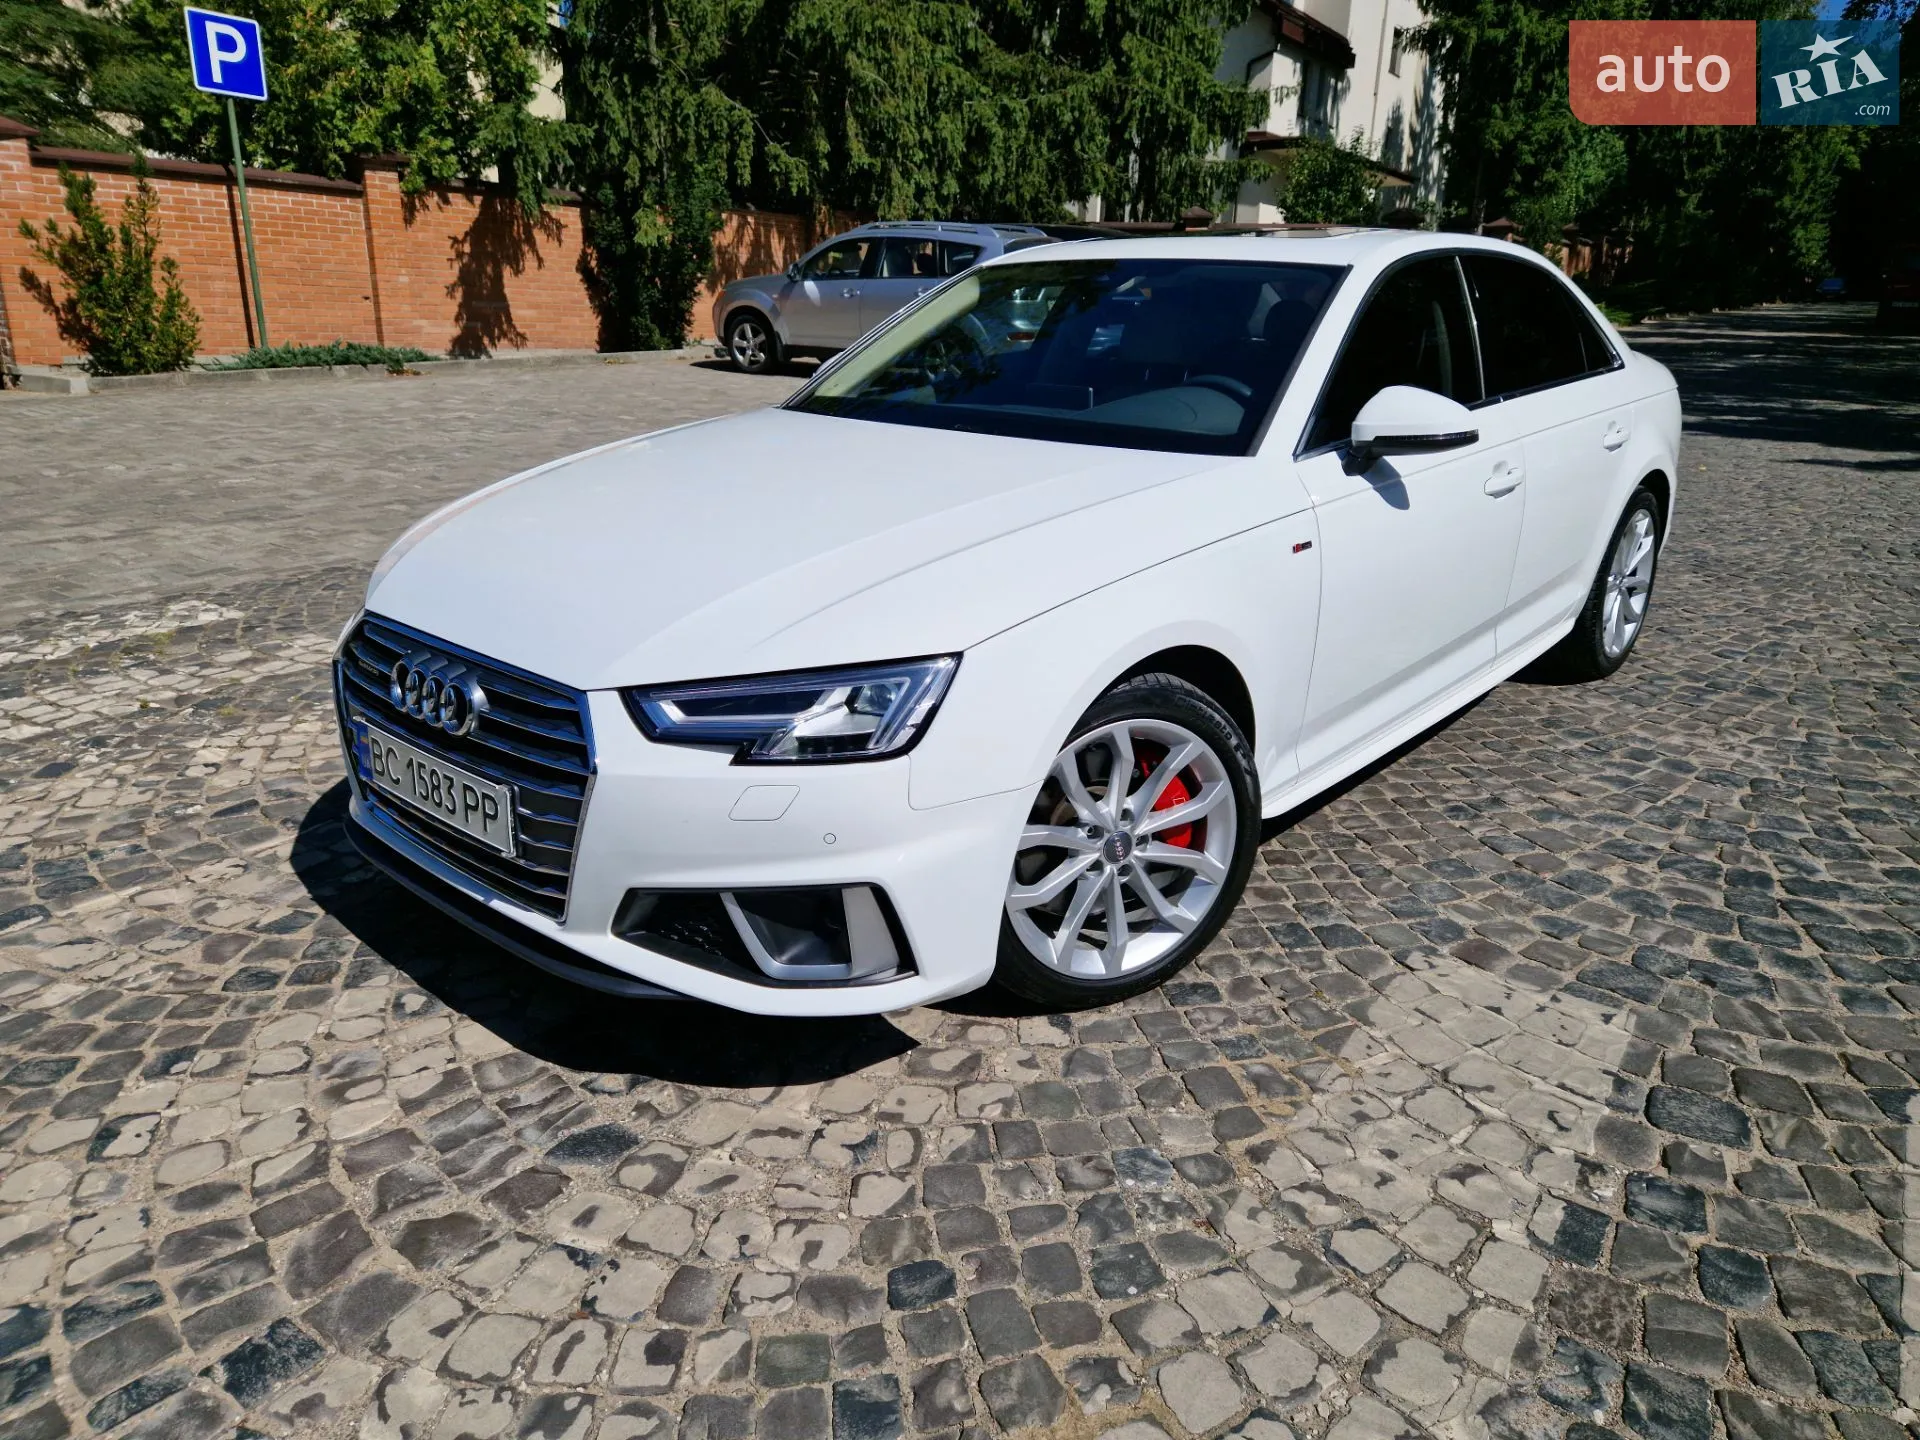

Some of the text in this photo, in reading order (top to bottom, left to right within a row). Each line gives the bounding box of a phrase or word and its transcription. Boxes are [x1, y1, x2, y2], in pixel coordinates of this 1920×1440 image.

[205, 20, 246, 84] P
[370, 735, 499, 833] BC 1583 PP
